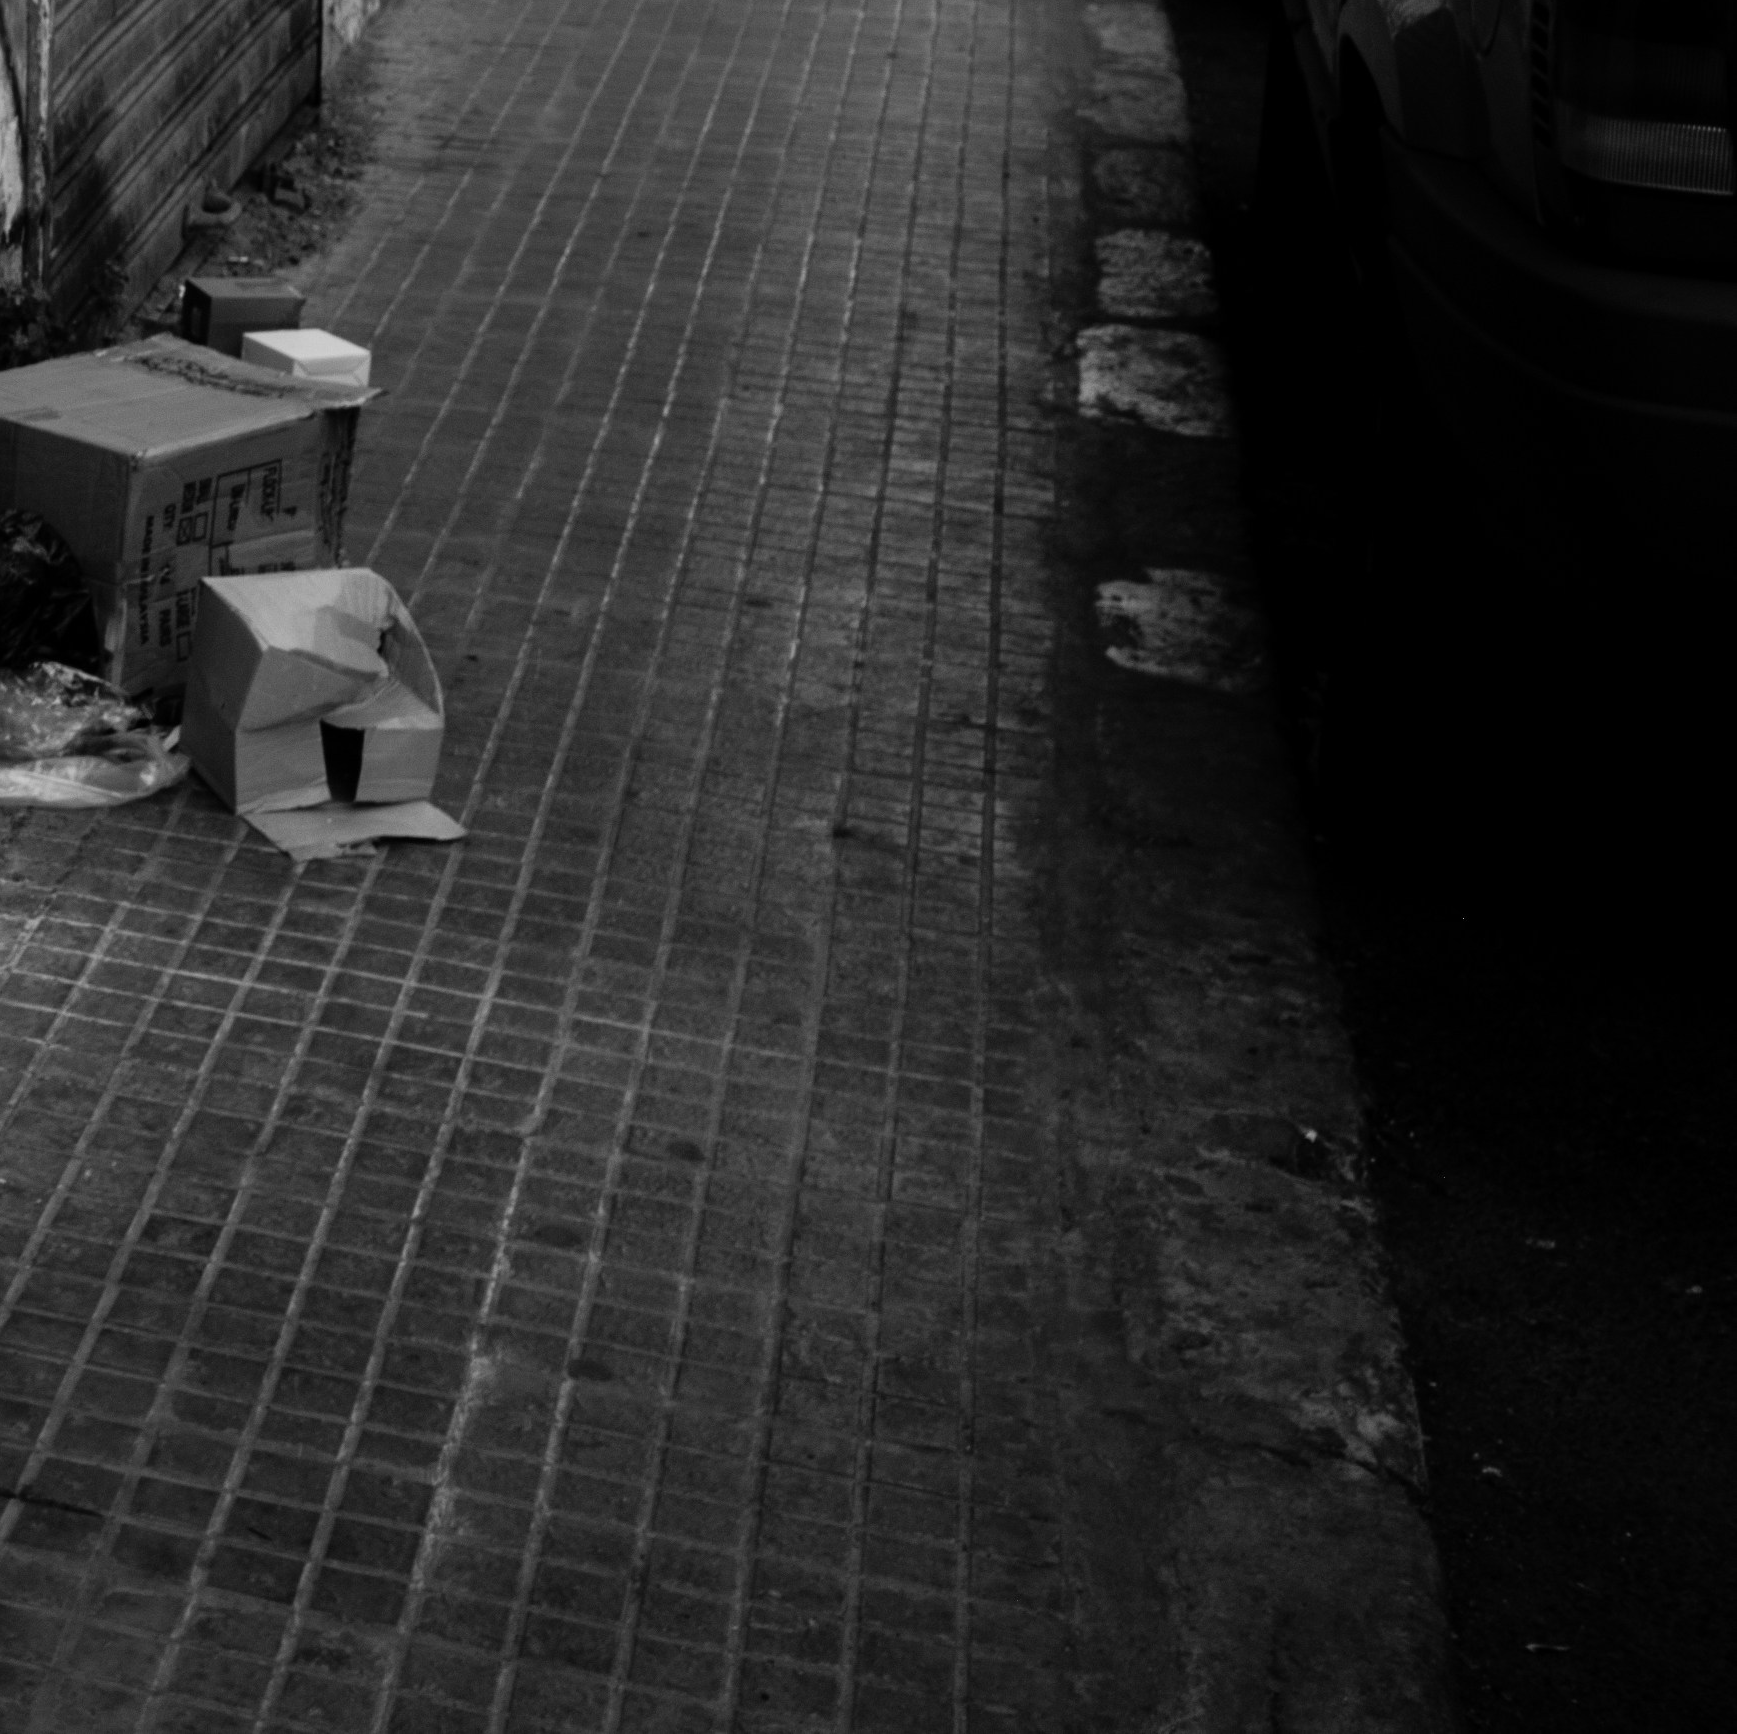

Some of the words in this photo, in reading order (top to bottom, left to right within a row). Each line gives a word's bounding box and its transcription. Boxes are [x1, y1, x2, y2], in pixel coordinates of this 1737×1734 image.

[142, 515, 154, 554] MADE
[164, 503, 177, 528] QTY
[140, 557, 149, 573] IN
[138, 580, 149, 645] MALAYSIA
[159, 608, 172, 647] PAIRS
